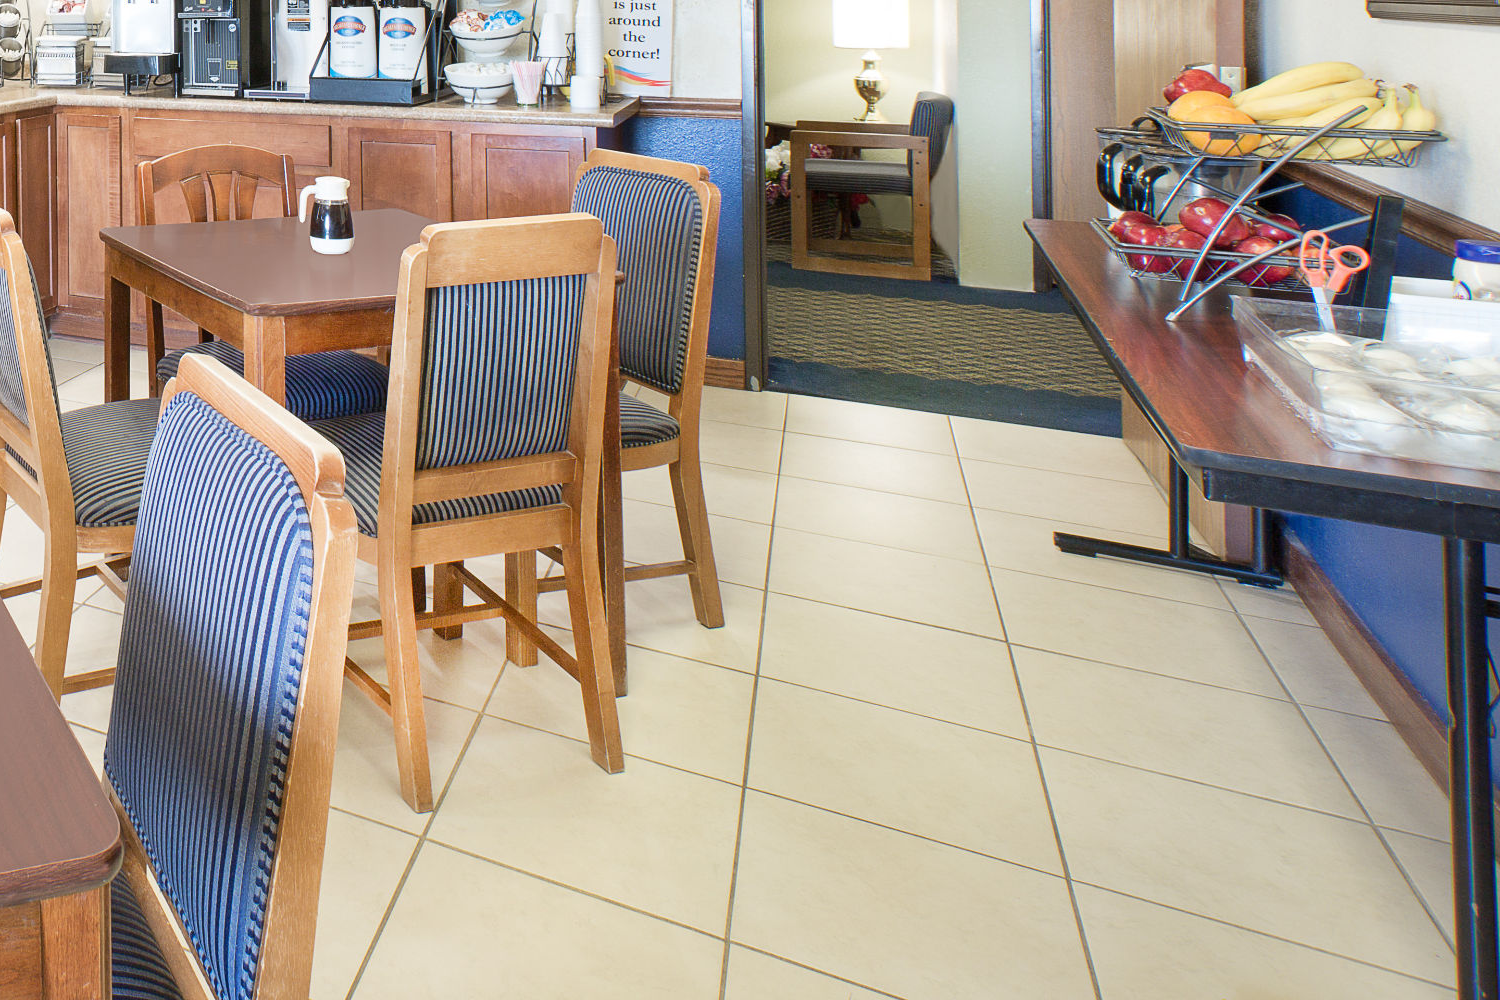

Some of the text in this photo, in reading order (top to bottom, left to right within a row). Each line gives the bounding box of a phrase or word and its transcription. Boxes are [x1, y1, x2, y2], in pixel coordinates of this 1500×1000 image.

[608, 16, 661, 27] around
[623, 31, 646, 42] the
[608, 48, 660, 60] corner!
